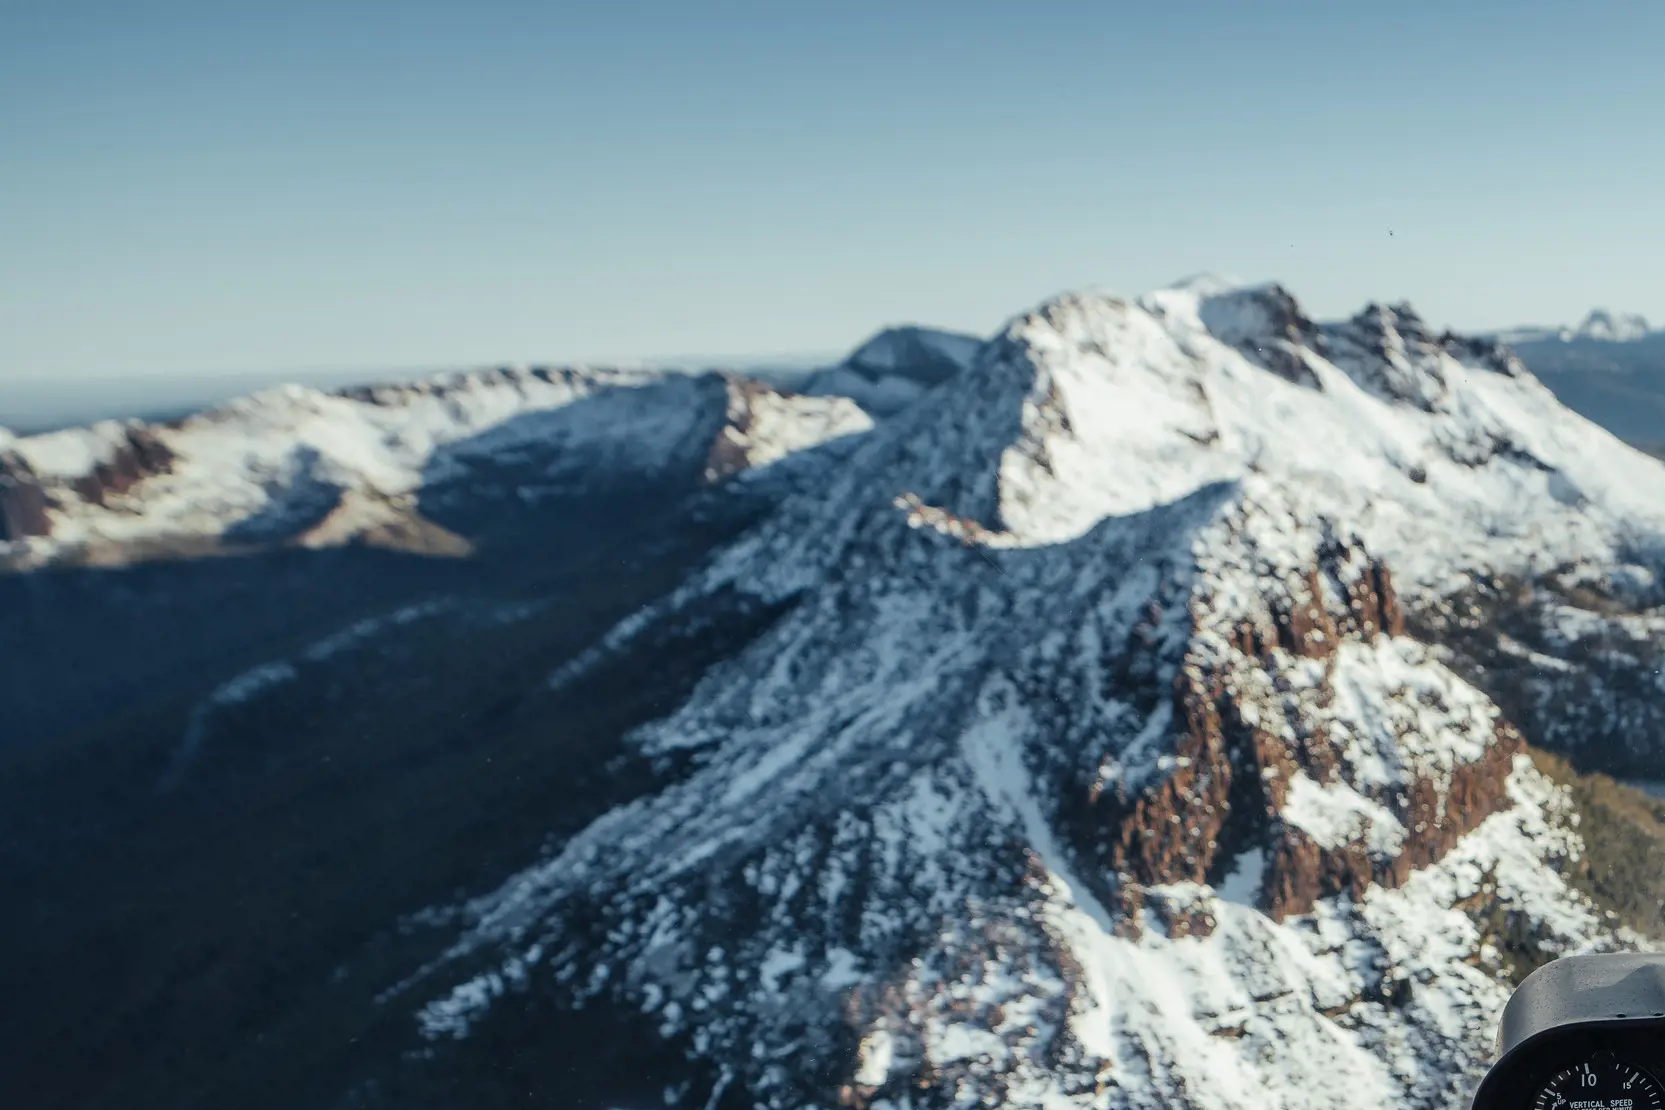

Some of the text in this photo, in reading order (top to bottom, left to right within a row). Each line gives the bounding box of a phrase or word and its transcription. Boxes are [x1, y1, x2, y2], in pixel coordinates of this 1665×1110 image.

[1582, 1073, 1598, 1088] 10
[1568, 1099, 1634, 1109] VERTICAL SPEED
